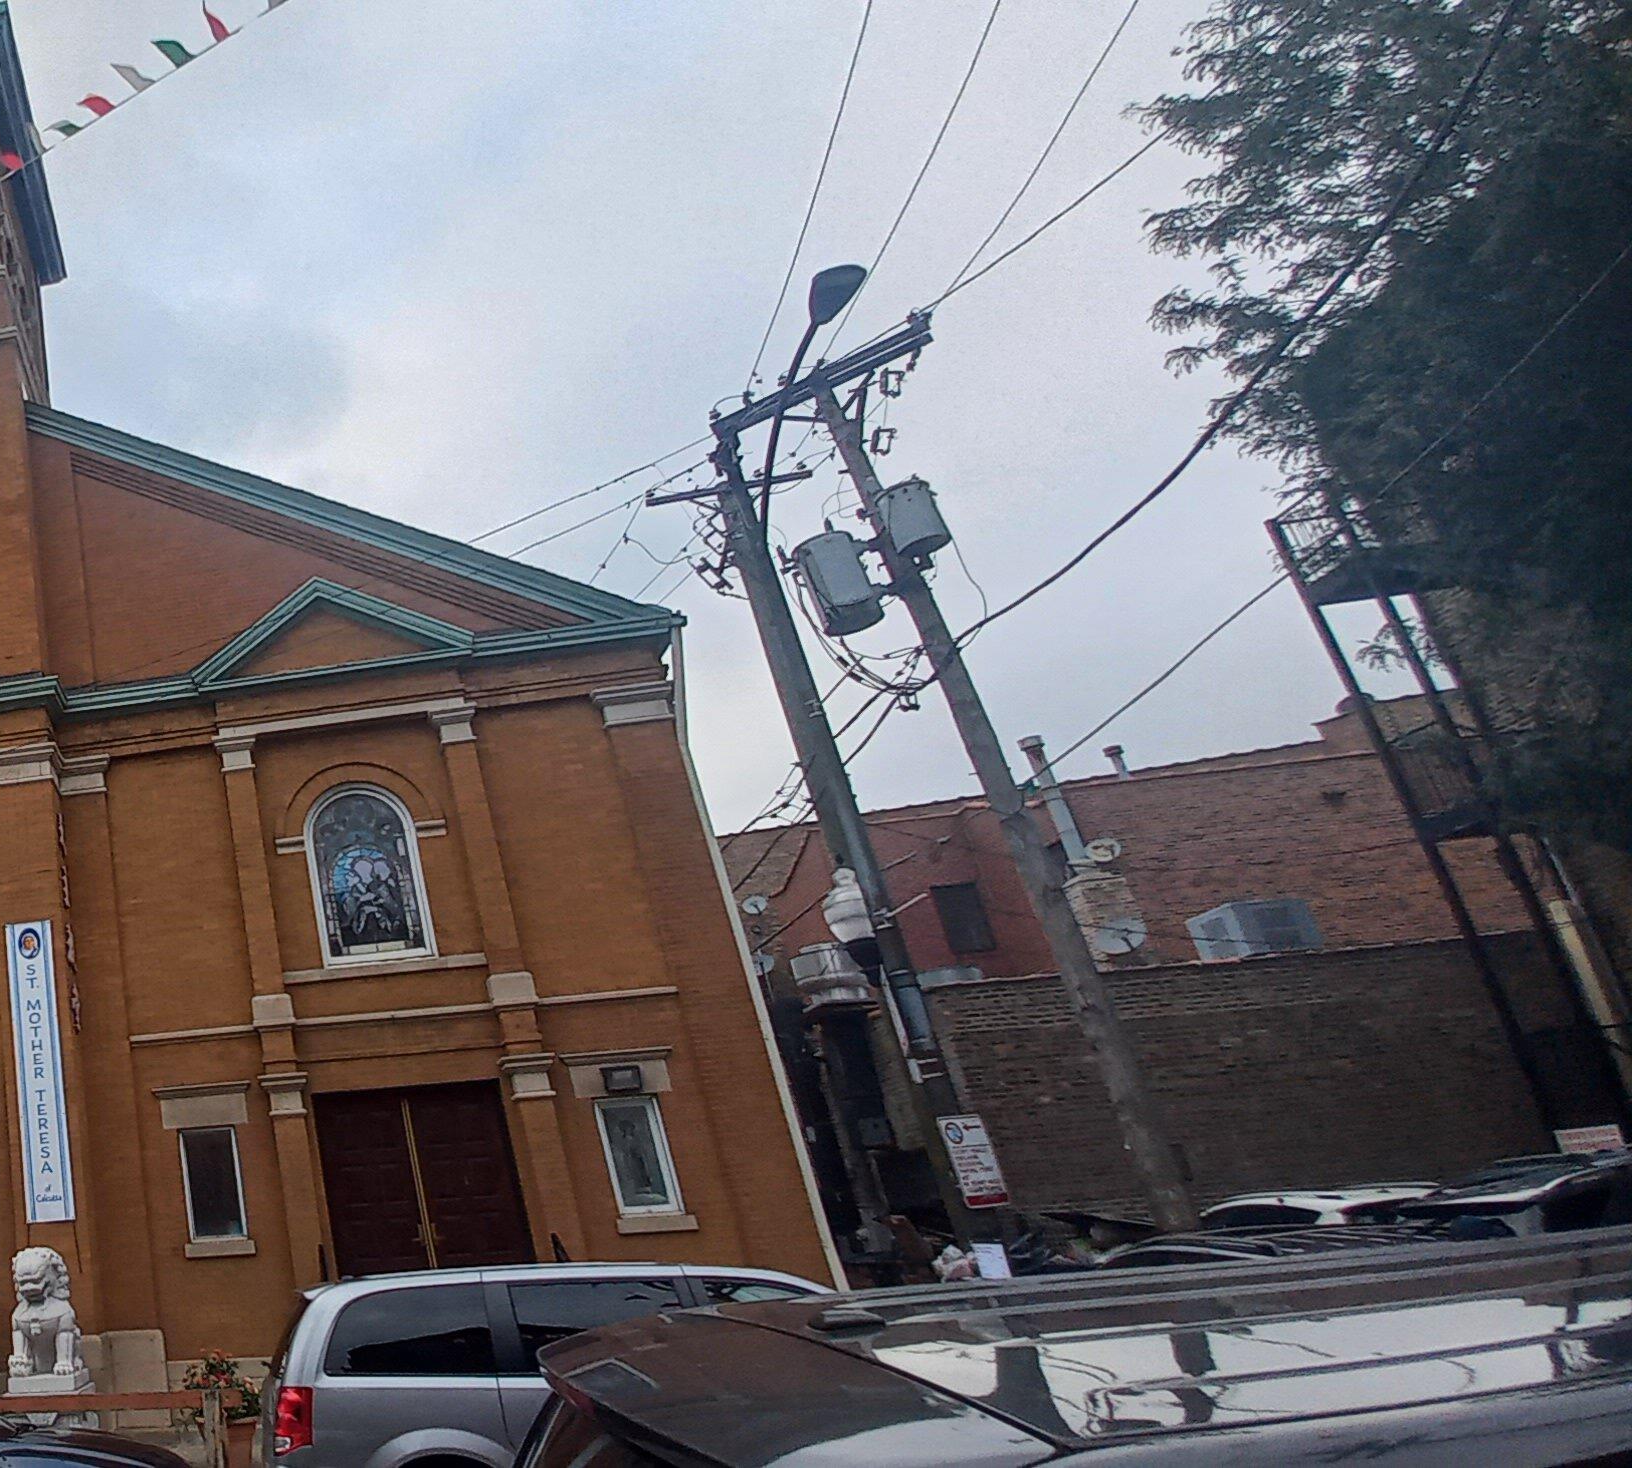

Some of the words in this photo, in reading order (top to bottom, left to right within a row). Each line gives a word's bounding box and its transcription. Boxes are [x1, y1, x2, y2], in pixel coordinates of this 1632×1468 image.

[26, 963, 40, 989] ST.
[26, 999, 45, 1079] MOTHER
[35, 1089, 53, 1174] TERESA
